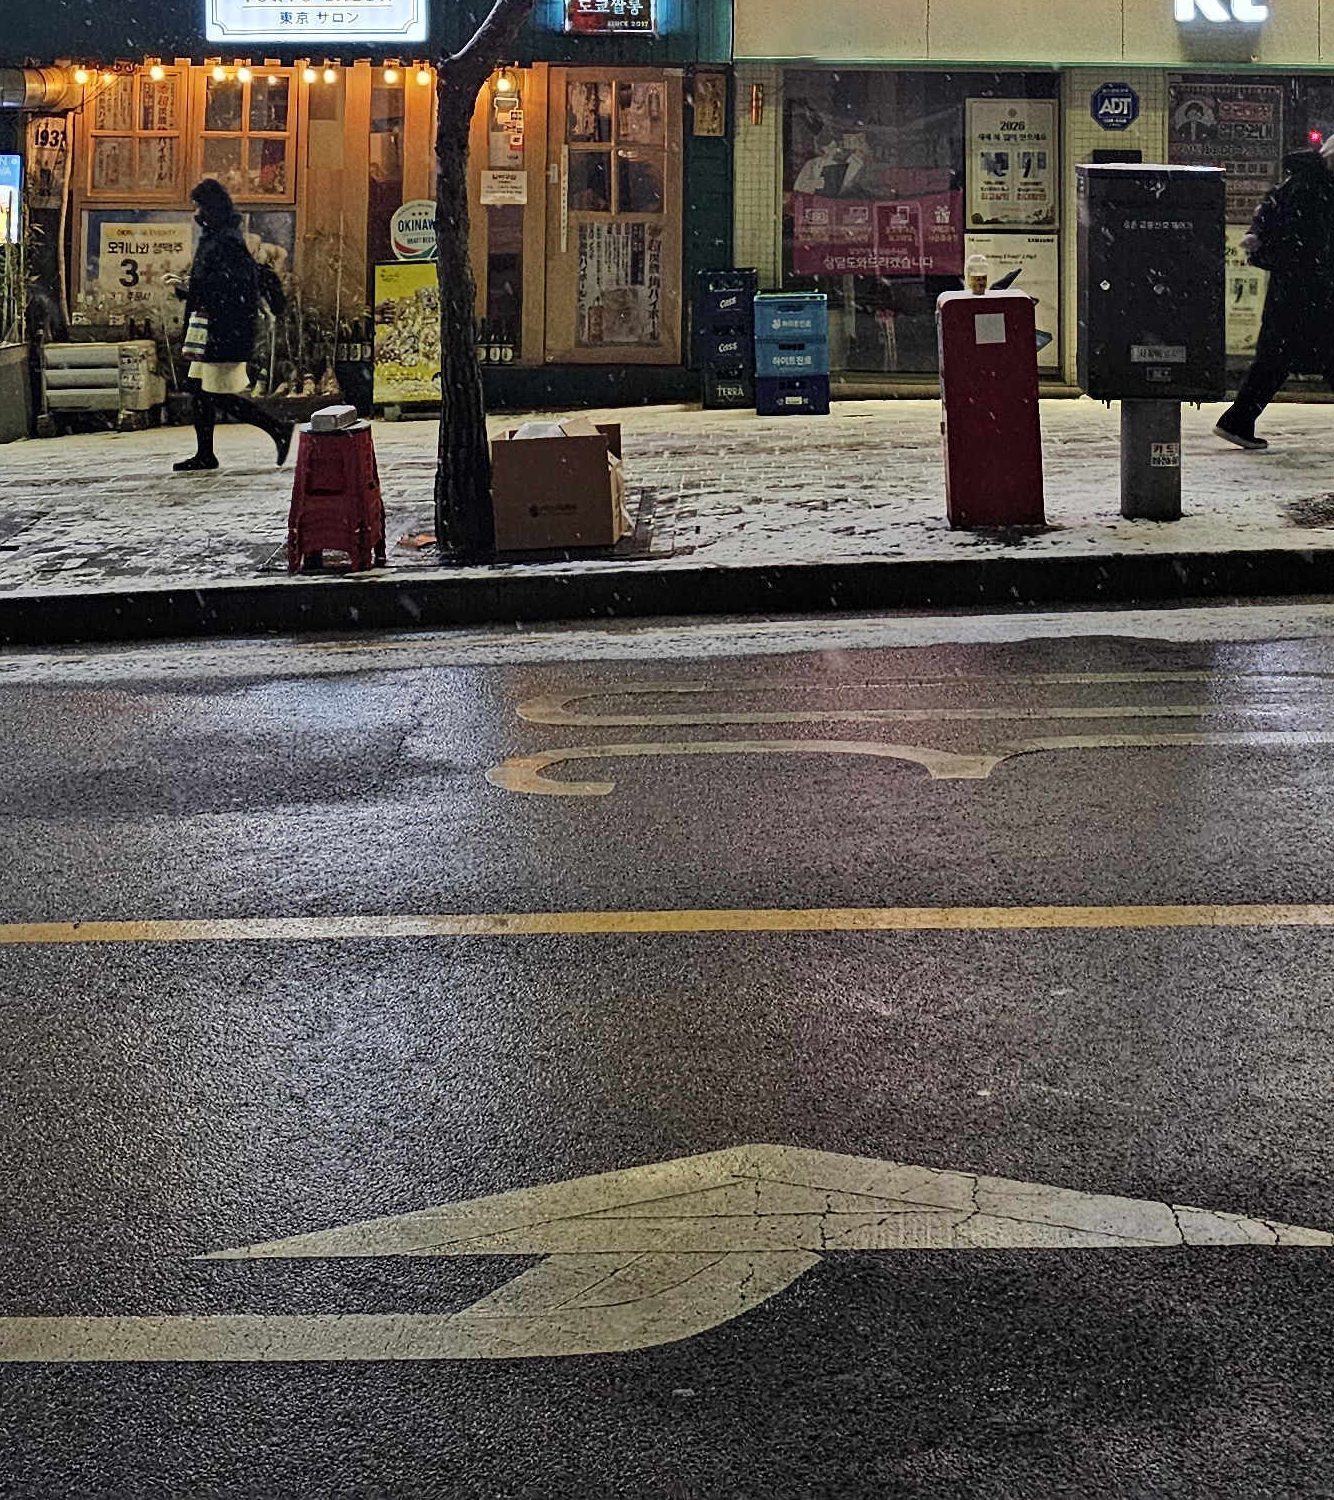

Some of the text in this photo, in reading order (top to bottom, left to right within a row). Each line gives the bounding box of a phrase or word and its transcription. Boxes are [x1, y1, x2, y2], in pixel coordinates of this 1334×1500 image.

[279, 11, 359, 25] 東京 サロン
[1099, 97, 1132, 114] ADT
[999, 121, 1026, 131] 2026
[398, 218, 435, 232] OKINAW
[107, 241, 149, 254] 오키나와
[719, 296, 737, 309] Cass
[718, 341, 738, 353] Cass
[772, 355, 813, 366] 하이트진로
[717, 385, 744, 397] TERRA
